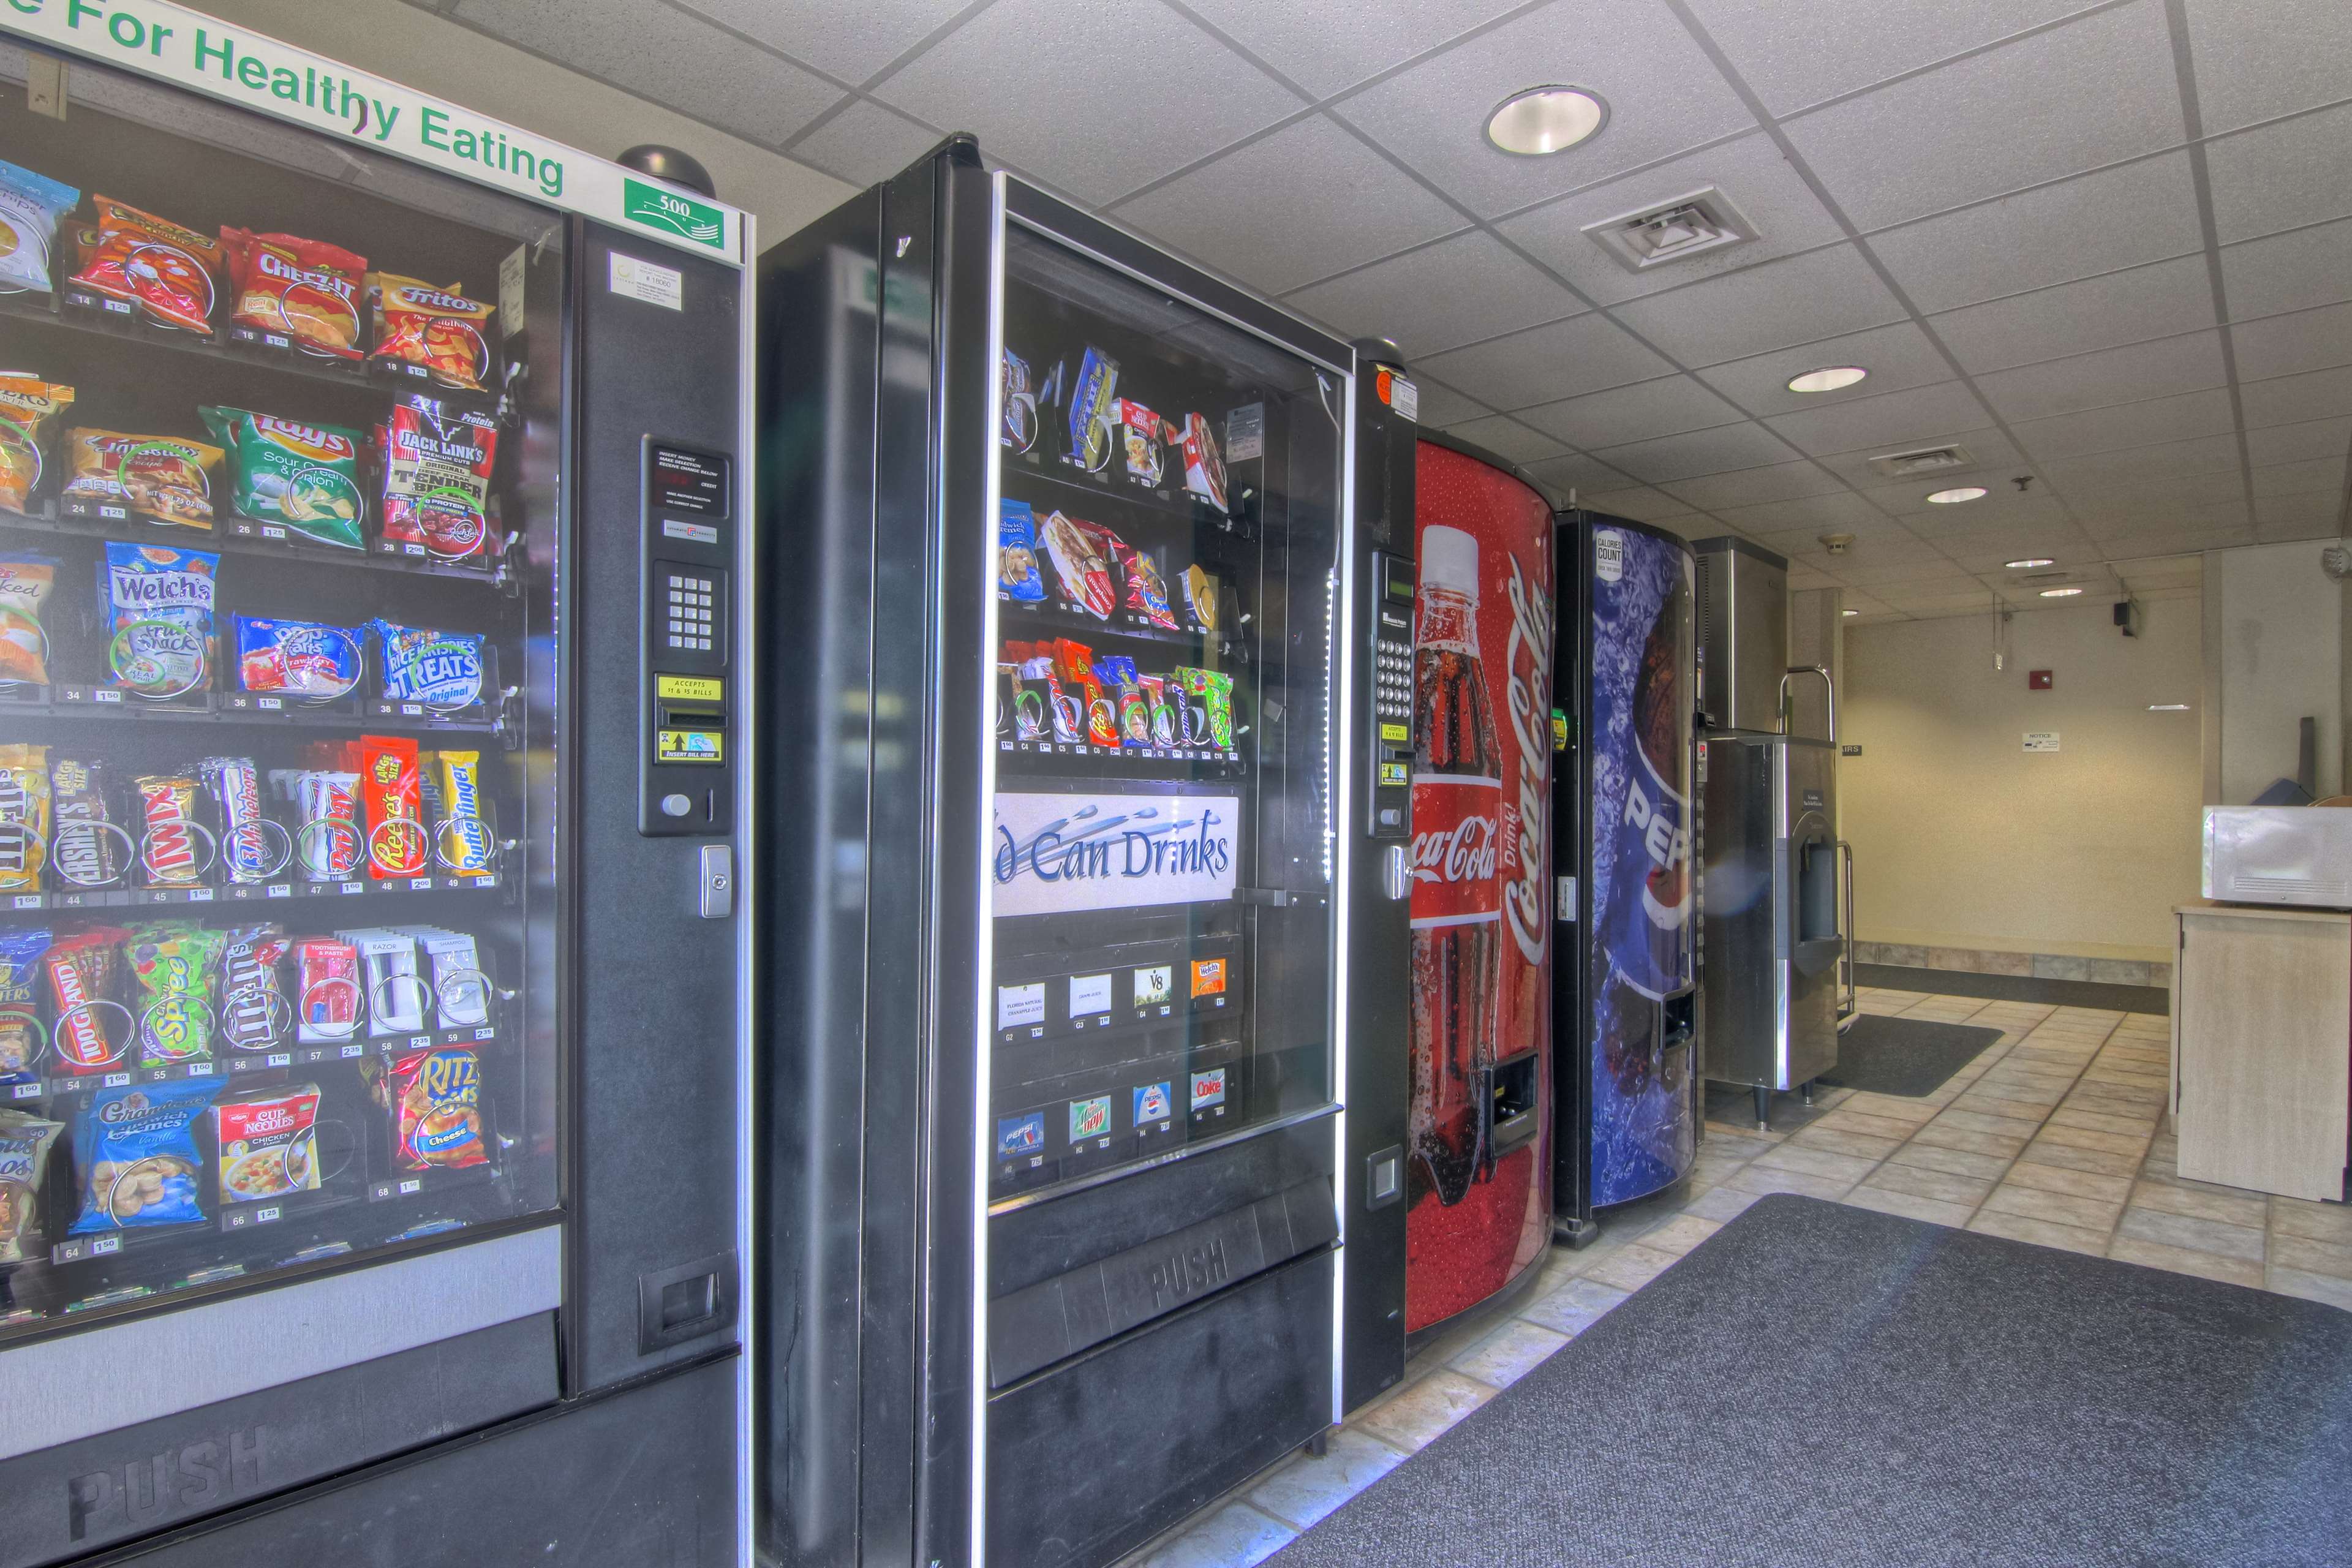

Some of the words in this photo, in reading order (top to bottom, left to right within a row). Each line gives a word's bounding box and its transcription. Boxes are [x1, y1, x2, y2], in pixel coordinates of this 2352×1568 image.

[67, 0, 173, 56] For
[194, 28, 399, 140] Healthy
[421, 106, 564, 197] Eating
[660, 194, 691, 217] 500
[260, 254, 356, 299] CHEEZ-IT
[78, 296, 90, 305] 14
[400, 287, 478, 312] Fritos
[413, 314, 427, 322] The
[243, 331, 254, 340] 16
[386, 361, 398, 371] 18
[461, 413, 494, 428] Protein
[402, 432, 439, 453] JACK
[441, 442, 484, 462] LINK'S
[264, 451, 300, 469] Sour
[421, 450, 452, 461] PREMIUM
[425, 461, 465, 475] ORIGINAL
[658, 456, 674, 464] MAKE
[674, 459, 701, 469] SELECTION
[658, 461, 679, 470] RECEIVE
[679, 465, 700, 474] CHANGE
[281, 466, 289, 475] &
[394, 469, 482, 500] TENDER
[72, 505, 85, 513] 24
[431, 499, 466, 510] PROTEIN
[238, 525, 251, 534] 26
[266, 528, 283, 537] 125
[1597, 537, 1622, 551] CALORIES
[1597, 547, 1622, 562] COUNT
[0, 578, 40, 598] ked
[116, 576, 211, 601] Welch's
[390, 647, 416, 672] RICE
[393, 655, 479, 698] TREATS
[67, 691, 80, 700] 34
[100, 692, 119, 701] 150
[429, 685, 469, 702] Original
[235, 699, 246, 707] 36
[262, 699, 279, 707] 150
[380, 705, 391, 714] 38
[375, 754, 394, 785] LARGE
[388, 762, 401, 781] SIZE
[54, 760, 75, 796] LARGE
[74, 767, 89, 790] SIZE
[145, 785, 195, 882] TWIX
[375, 791, 405, 870] Reese's
[1504, 802, 1519, 868] Drink!
[55, 801, 102, 882] ERSHEY'S
[1031, 831, 1109, 883] Can
[1121, 809, 1228, 880] Drinks
[1411, 815, 1497, 882] ca-Cola
[413, 880, 430, 889] 200
[448, 880, 458, 888] 49
[478, 876, 492, 885] 160
[270, 885, 288, 895] 160
[311, 886, 322, 895] 47
[344, 883, 360, 892] 160
[382, 883, 393, 891] 48
[154, 892, 167, 902] 45
[192, 889, 211, 899] 160
[235, 889, 247, 898] 46
[67, 896, 81, 905] 44
[439, 939, 466, 948] SHAMPOO
[1199, 962, 1220, 975] Welch's
[1150, 974, 1163, 990] V8
[154, 956, 190, 1044] Spree
[1025, 998, 1042, 1007] NATURAL
[448, 1034, 458, 1042] 59
[477, 1029, 492, 1038] 235
[1005, 1033, 1014, 1041] G2
[76, 1028, 102, 1059] 100
[382, 1042, 392, 1051] 58
[412, 1037, 428, 1047] 235
[310, 1051, 322, 1060] 57
[344, 1046, 360, 1055] 235
[271, 1054, 288, 1064] 160
[192, 1063, 210, 1073] 160
[234, 1061, 246, 1070] 56
[108, 1074, 127, 1085] 160
[154, 1071, 167, 1080] 55
[422, 1057, 480, 1093] RITZ
[18, 1085, 39, 1096] 160
[67, 1081, 80, 1090] 54
[1196, 1080, 1221, 1097] Coke
[1144, 1093, 1162, 1103] PEPSI
[257, 1109, 286, 1123] CUP
[244, 1115, 295, 1134] NOODLES
[429, 1126, 467, 1147] Cheese
[1006, 1123, 1034, 1143] PEPSI
[1139, 1129, 1147, 1137] H4
[252, 1133, 291, 1145] CHICKEN
[1005, 1166, 1013, 1174] H2
[378, 1188, 389, 1197] 68
[260, 1208, 277, 1219] 125
[232, 1216, 244, 1226] 66
[96, 1240, 115, 1252] 150
[66, 1248, 79, 1259] 64
[1152, 1238, 1229, 1310] PUSH
[68, 1423, 267, 1542] PUSH
